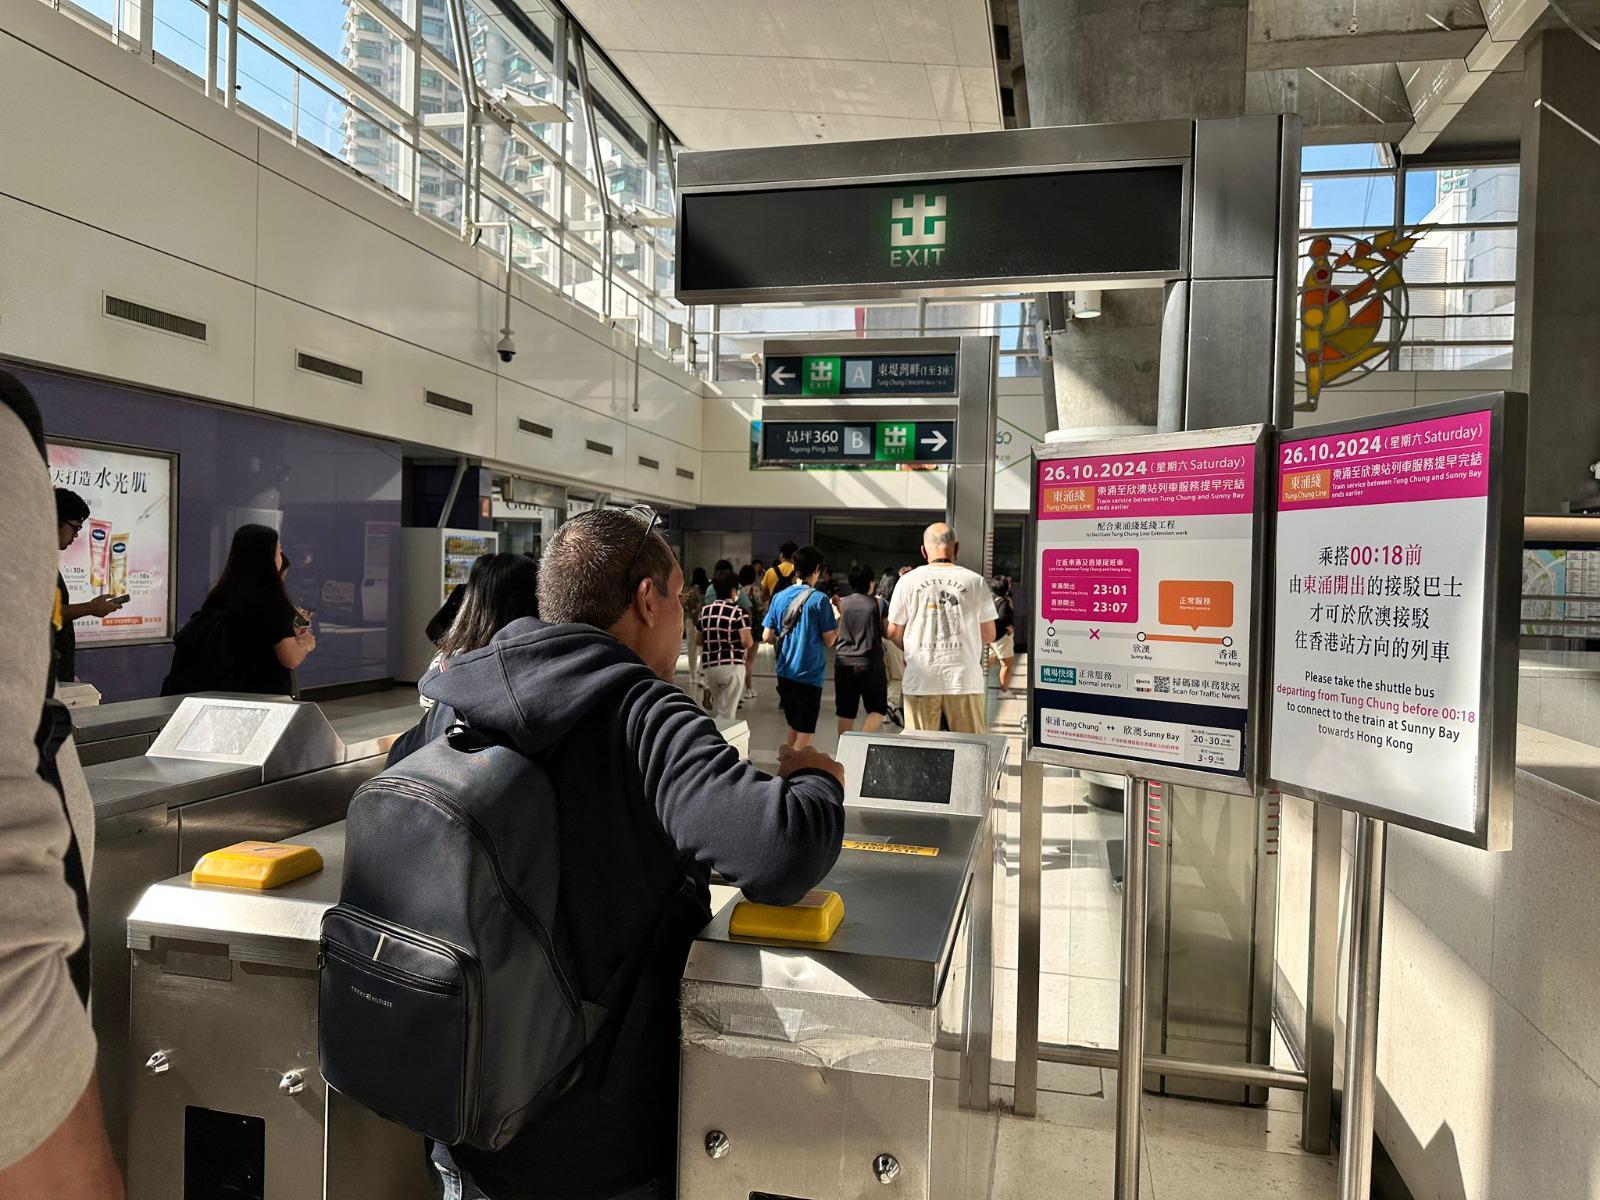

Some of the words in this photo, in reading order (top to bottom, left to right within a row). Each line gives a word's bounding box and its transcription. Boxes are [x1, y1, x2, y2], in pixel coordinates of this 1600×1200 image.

[890, 248, 946, 267] EXIT
[853, 366, 865, 383] A
[809, 381, 831, 390] EXIT
[786, 429, 839, 443] 昂坪360
[851, 431, 864, 449] B
[789, 446, 810, 454] Ngong
[826, 445, 839, 453] 360
[1283, 435, 1382, 465] 26.10.2024
[1424, 423, 1483, 444] Saturday)
[884, 447, 905, 455] EXIT
[1044, 460, 1147, 481] 26.10.2024
[1190, 455, 1245, 470] Saturday)
[1333, 451, 1483, 480] 東涌至欣澳站列車服務提早完結
[1346, 481, 1366, 489] service
[1366, 479, 1392, 487] between
[1393, 477, 1408, 485] Tung
[1409, 475, 1430, 483] Chung
[1431, 472, 1444, 480] and
[1445, 471, 1467, 480] Sunny
[1468, 469, 1482, 478] Bay
[1159, 495, 1175, 503] Tung
[1176, 494, 1196, 502] Chung
[1232, 491, 1245, 499] Bay
[1285, 492, 1297, 500] Tung
[1297, 491, 1315, 499] Chung
[1331, 490, 1345, 498] ends
[1345, 489, 1363, 497] earlier
[1061, 503, 1078, 511] Chung
[1093, 584, 1127, 595] 23:01
[1289, 574, 1463, 598] 由東涌開出的接駁巴士
[1092, 601, 1128, 613] 23:07
[1310, 603, 1430, 630] 才可於欣澳接駁
[1295, 630, 1450, 663] 往香港站方向的列車
[1219, 649, 1238, 660] 香港
[1079, 670, 1112, 681] 正常服務
[1100, 681, 1121, 689] service
[1305, 671, 1332, 685] Please
[1334, 675, 1354, 687] take
[1356, 677, 1373, 690] the
[1375, 679, 1412, 695] shuttle
[1414, 684, 1435, 698] bus
[1172, 687, 1188, 695] Scan
[1189, 688, 1198, 696] for
[1200, 689, 1220, 698] Traffic
[1221, 692, 1241, 700] News
[1276, 683, 1316, 701] departing
[1318, 688, 1339, 702] from
[1340, 692, 1364, 709] Tung
[1366, 696, 1399, 715] Chung
[1402, 701, 1439, 717] before
[1441, 707, 1475, 723] 00:18
[1061, 719, 1077, 729] Tung
[1287, 701, 1296, 712] to
[1297, 704, 1331, 718] connect
[1332, 709, 1342, 720] to
[1344, 710, 1360, 723] the
[1362, 714, 1385, 728] train
[1387, 719, 1399, 730] at
[1401, 719, 1435, 739] Sunny
[1438, 725, 1460, 743] Bay
[1143, 729, 1164, 740] Sunny
[1166, 732, 1180, 742] Bay
[1193, 735, 1204, 743] 20
[1209, 736, 1220, 745] 30
[1318, 724, 1354, 739] towards
[1356, 730, 1383, 748] Hong
[1386, 735, 1413, 753] Kong
